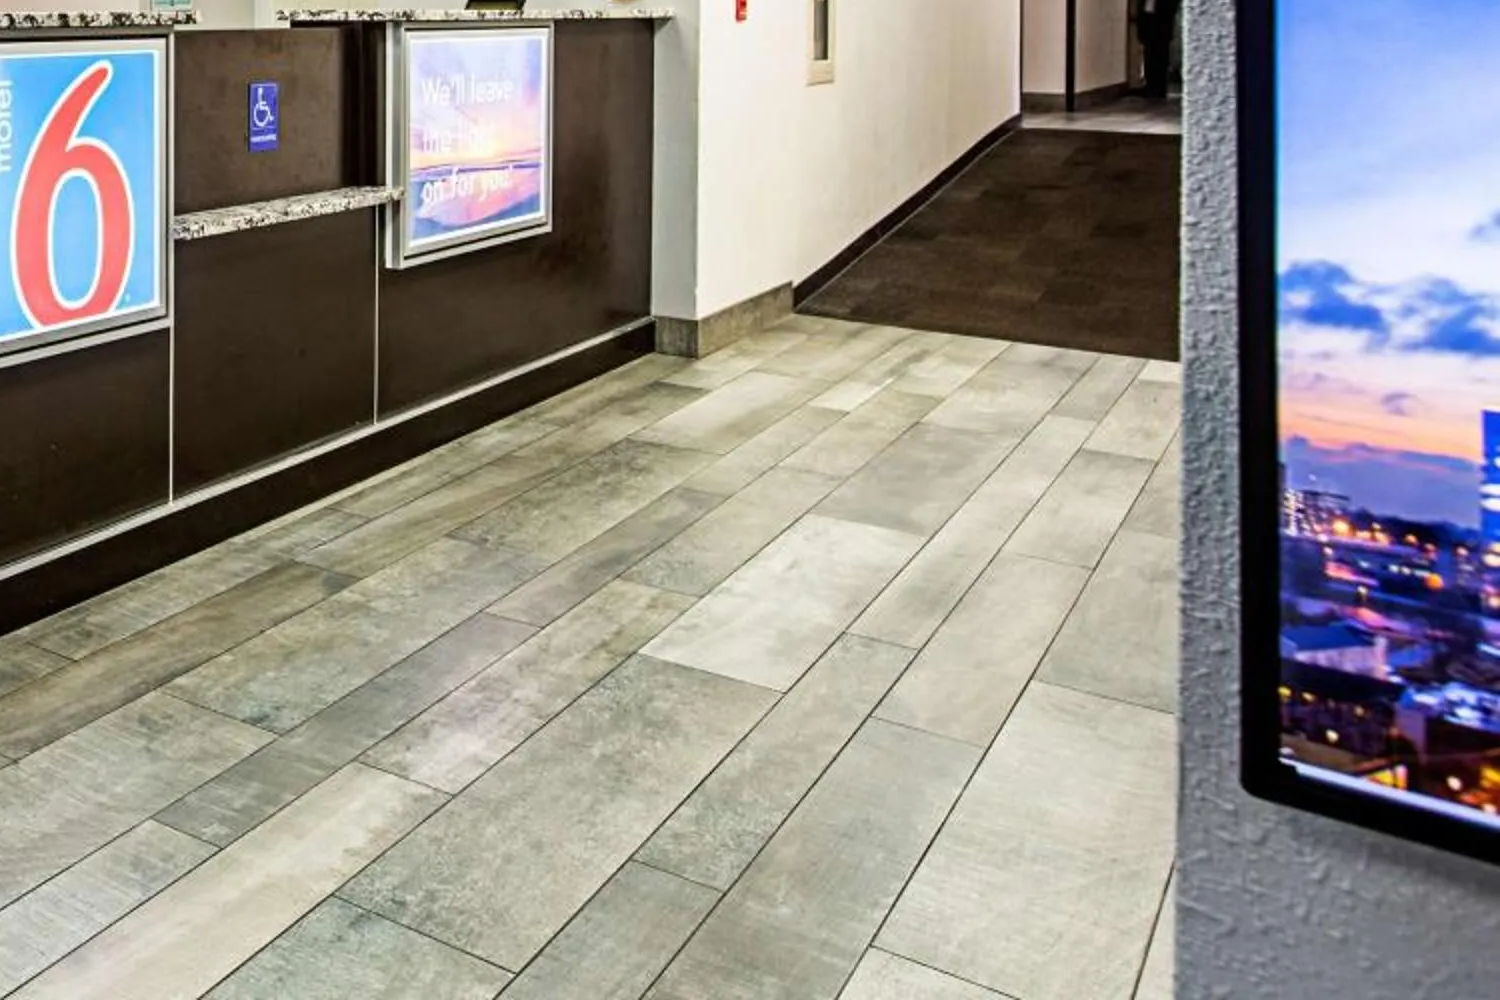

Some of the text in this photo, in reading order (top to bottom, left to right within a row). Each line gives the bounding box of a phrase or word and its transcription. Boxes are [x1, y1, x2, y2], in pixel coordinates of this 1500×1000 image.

[471, 71, 515, 105] leave
[10, 60, 135, 330] 6
[422, 179, 445, 204] on
[451, 168, 474, 197] for
